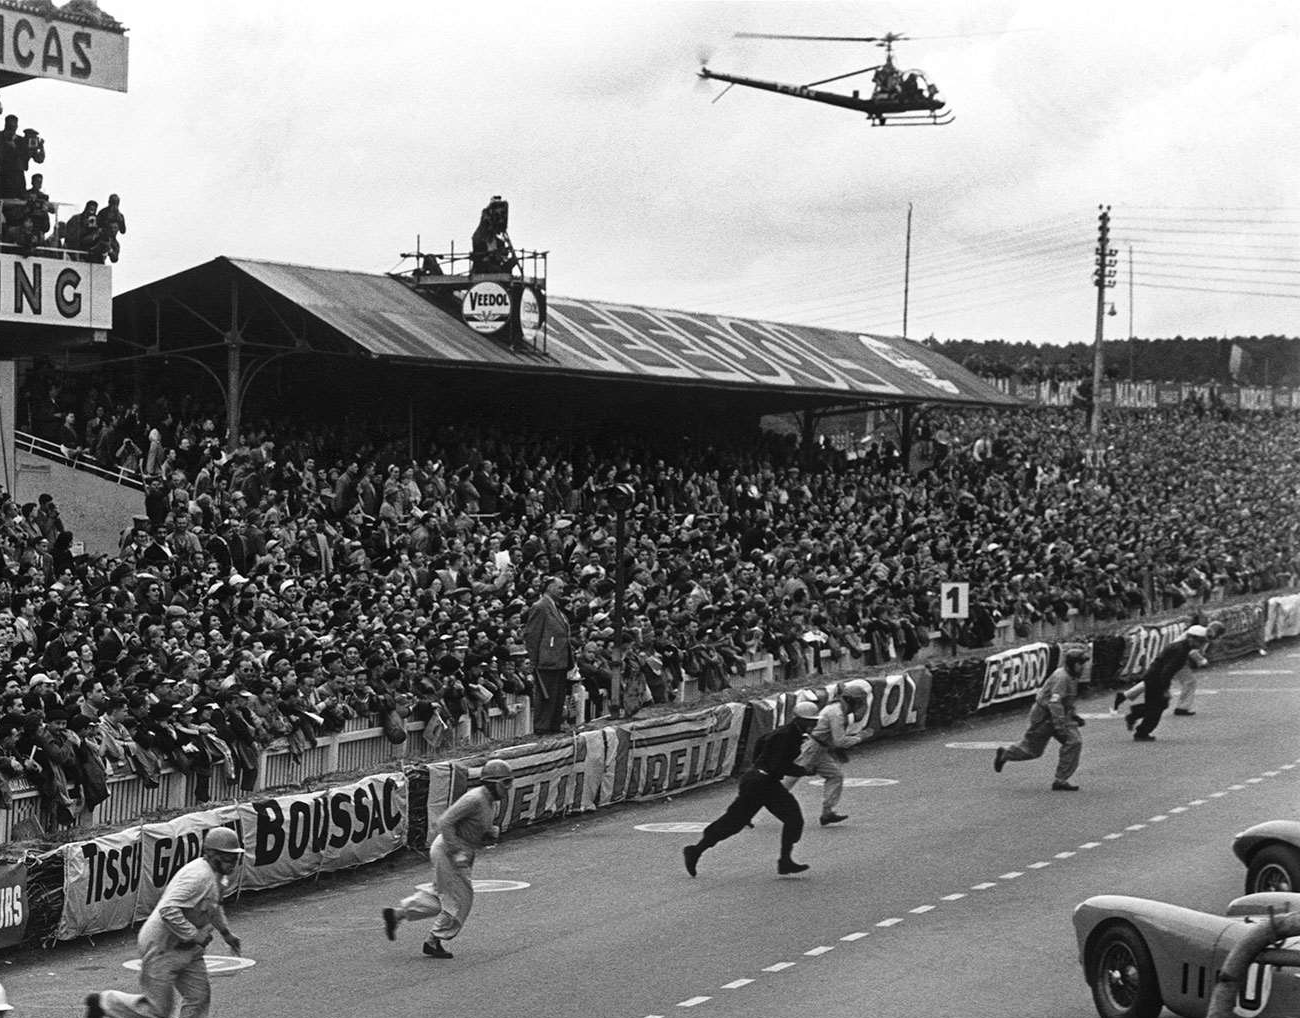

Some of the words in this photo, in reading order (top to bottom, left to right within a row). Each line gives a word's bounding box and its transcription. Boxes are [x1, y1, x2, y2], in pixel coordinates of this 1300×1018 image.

[470, 292, 509, 311] VEEDOL
[946, 586, 960, 614] 1
[984, 649, 1047, 700] FERODO
[82, 841, 142, 905] TISSU
[253, 777, 400, 867] BOUSSAC
